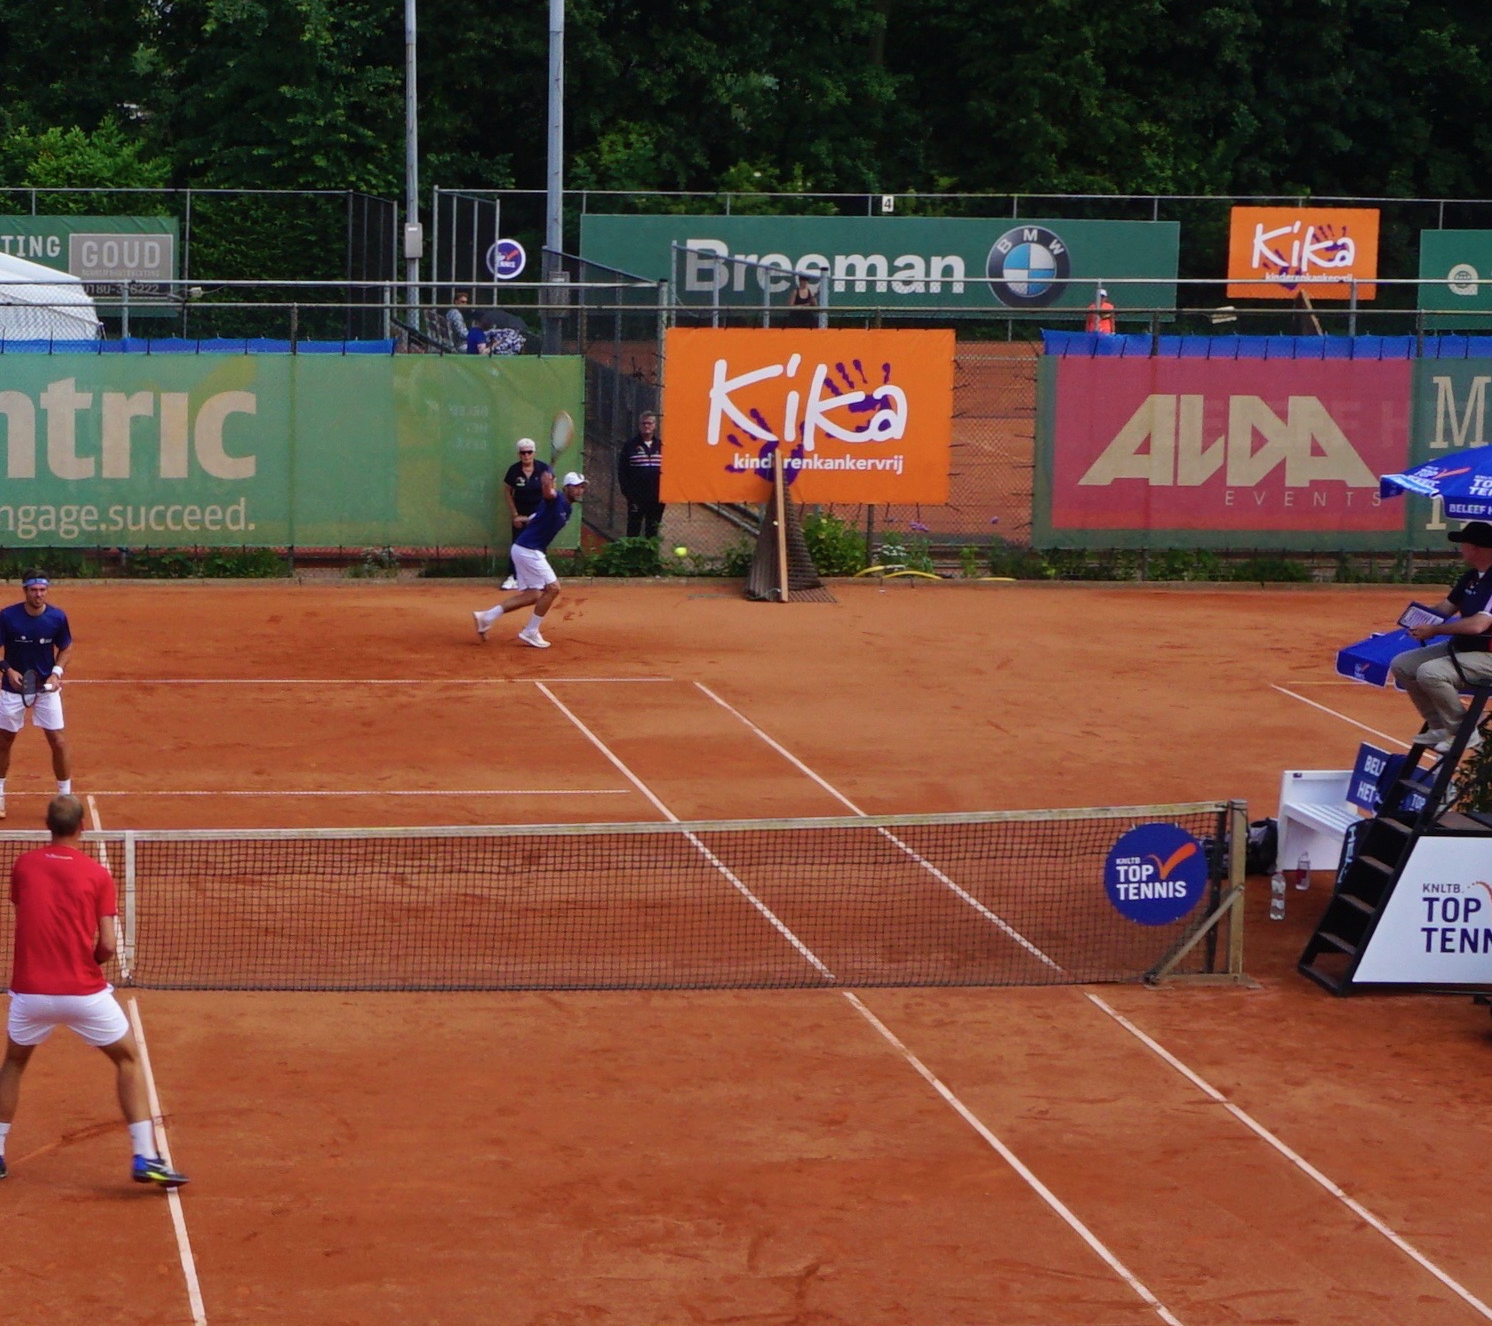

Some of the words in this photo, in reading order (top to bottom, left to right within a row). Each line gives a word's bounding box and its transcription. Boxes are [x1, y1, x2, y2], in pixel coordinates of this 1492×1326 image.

[883, 198, 893, 211] 4
[996, 228, 1065, 256] BMW
[81, 240, 161, 268] GOUD
[684, 238, 965, 294] Breeman
[733, 453, 904, 474] kindrenkankervrij
[1225, 490, 1381, 506] EVENTS
[1449, 503, 1486, 515] BELEEF
[1116, 864, 1154, 883] TOP
[1116, 881, 1187, 901] TENNIS
[1422, 883, 1462, 894] KNLTB
[1422, 897, 1482, 923] TOP
